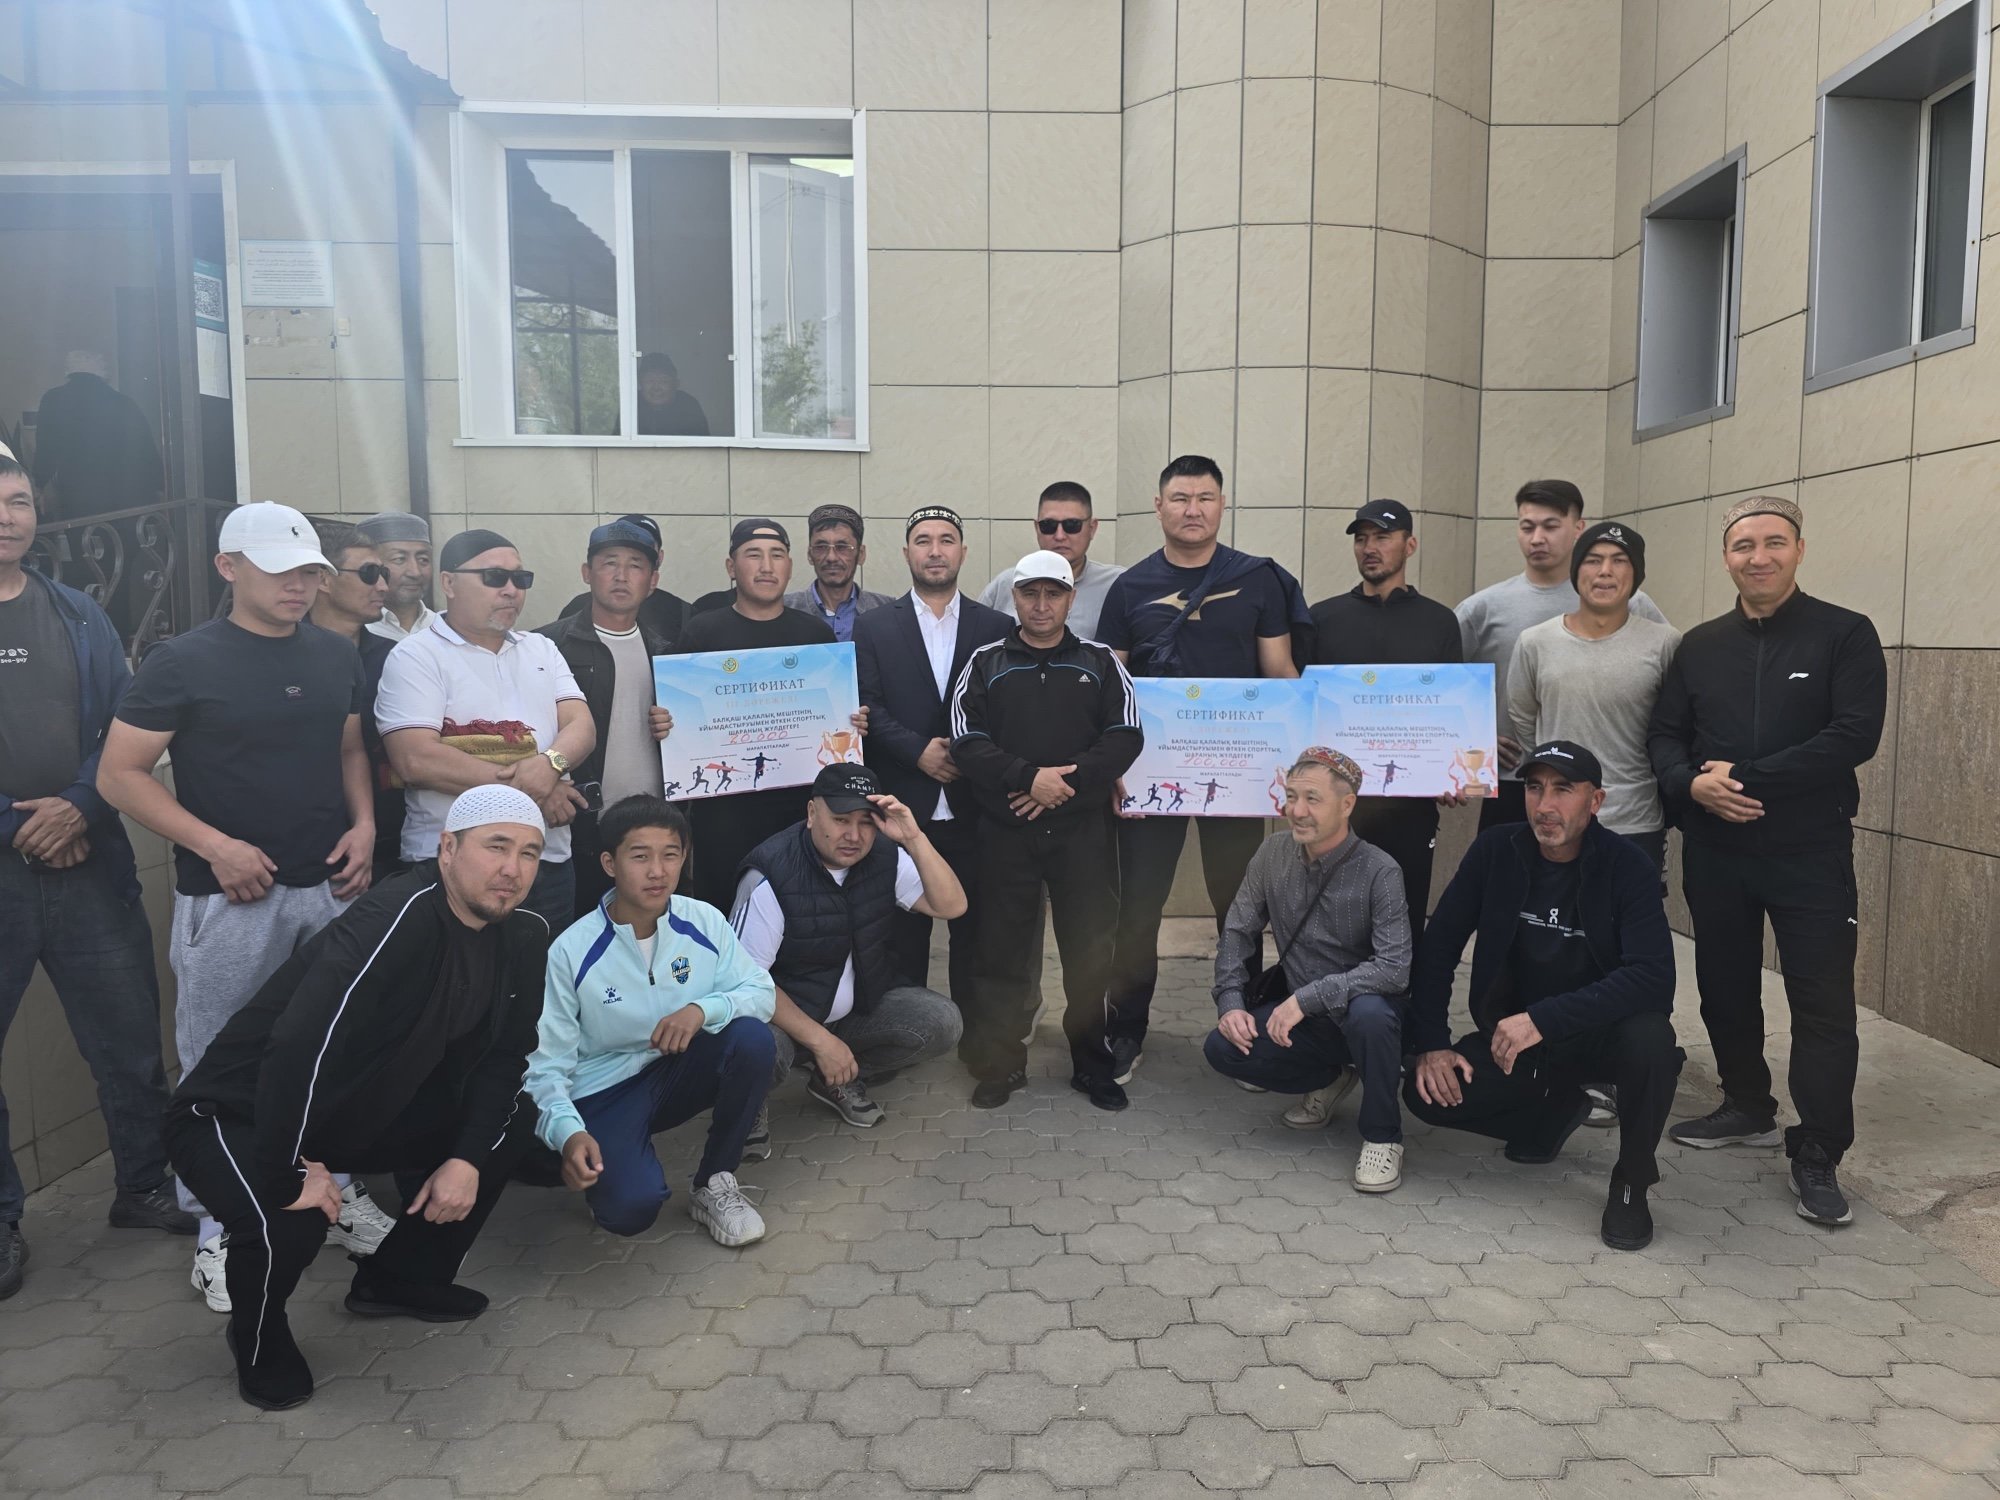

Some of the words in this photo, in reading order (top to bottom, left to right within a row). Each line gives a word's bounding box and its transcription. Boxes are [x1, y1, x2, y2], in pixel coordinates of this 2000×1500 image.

[715, 678, 805, 696] СЕРТИФИКАТ
[1353, 694, 1441, 705] СЕРТИФИКАТ
[713, 715, 742, 724] БАЛҚАШ
[1176, 709, 1265, 721] СЕРТИФИКАТ
